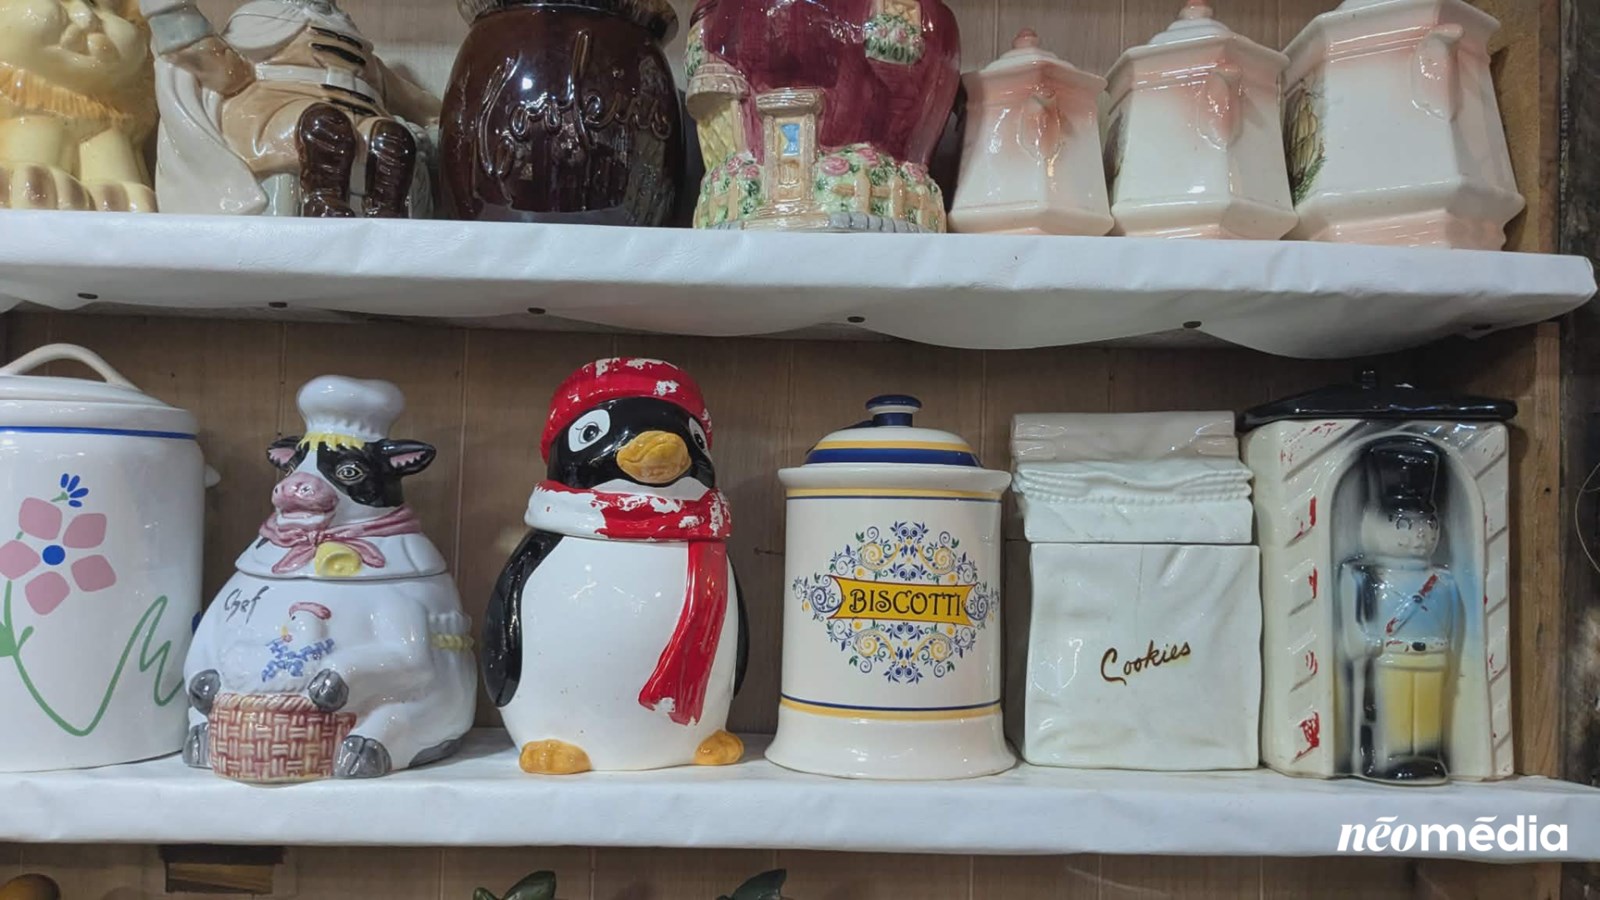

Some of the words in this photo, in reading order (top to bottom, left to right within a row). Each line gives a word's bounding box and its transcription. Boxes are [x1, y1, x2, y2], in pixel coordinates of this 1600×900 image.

[224, 585, 269, 624] Chef
[849, 588, 961, 617] BISCOTTI
[1100, 640, 1191, 686] Cookies
